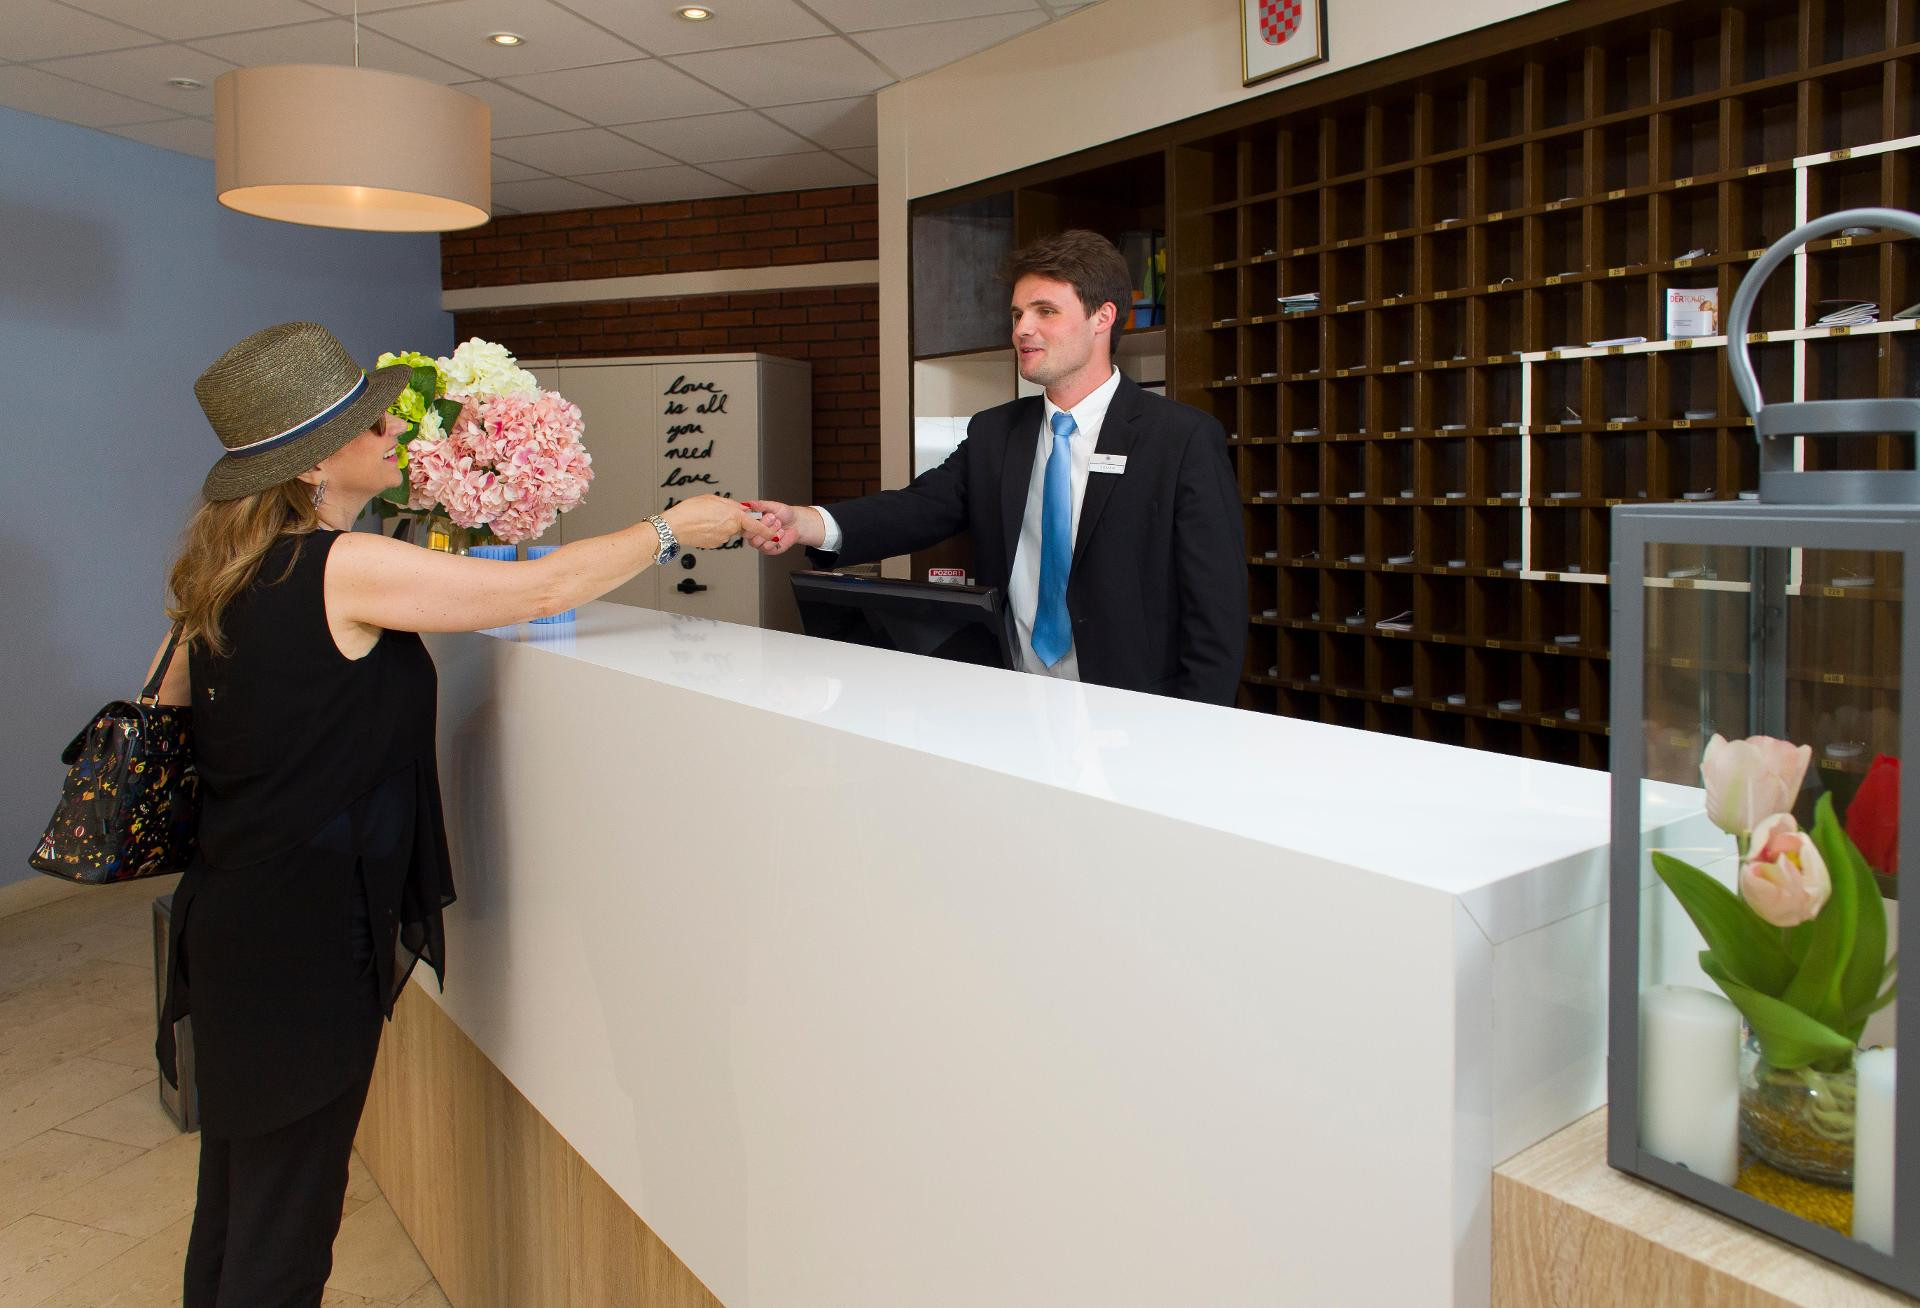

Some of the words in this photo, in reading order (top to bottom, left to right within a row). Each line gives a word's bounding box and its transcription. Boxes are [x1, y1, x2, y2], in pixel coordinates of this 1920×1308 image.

[664, 375, 722, 395] love
[664, 401, 688, 415] is
[696, 394, 728, 414] all
[666, 423, 704, 443] you
[664, 440, 714, 459] need
[660, 467, 719, 487] love
